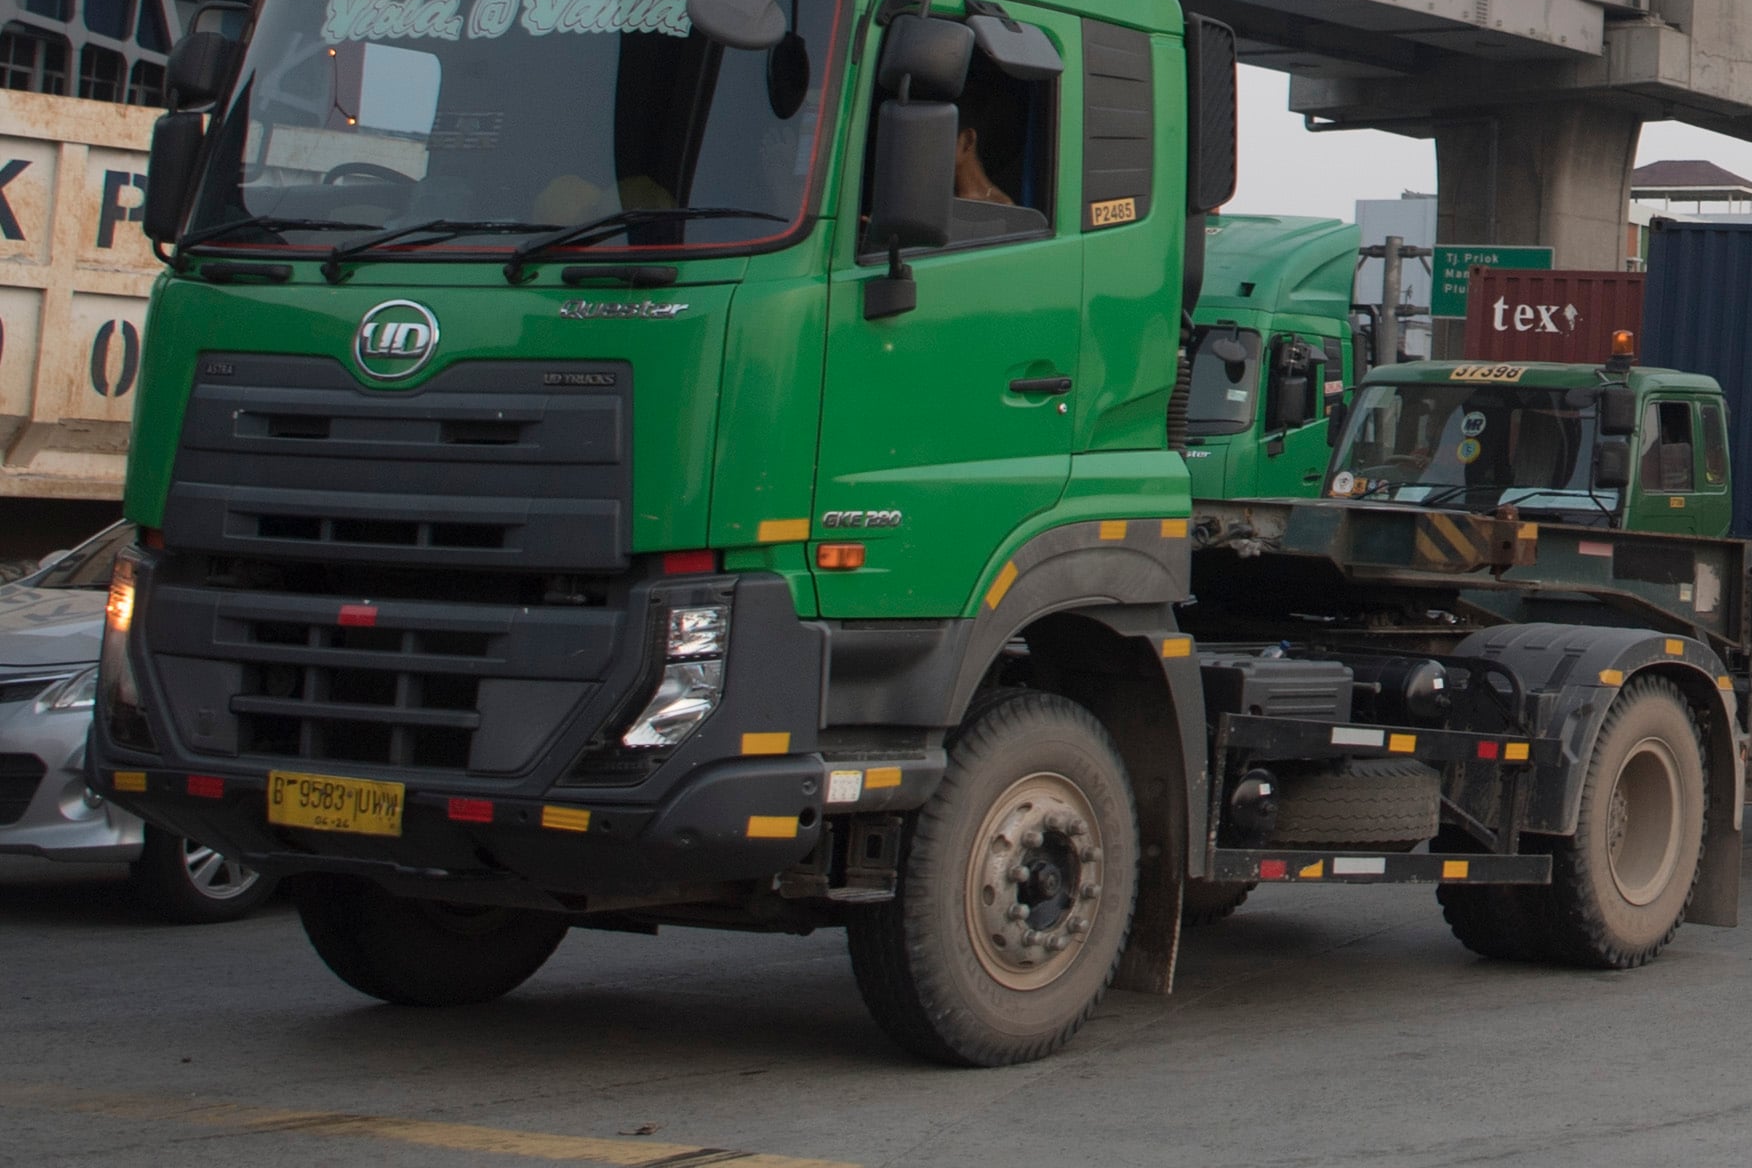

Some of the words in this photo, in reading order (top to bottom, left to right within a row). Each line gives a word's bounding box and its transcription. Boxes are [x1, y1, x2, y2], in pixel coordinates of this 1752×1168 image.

[1094, 202, 1133, 224] P2485
[1464, 253, 1499, 264] Priok
[1444, 269, 1470, 279] Man
[1444, 283, 1468, 294] Plu
[559, 299, 690, 320] Quester
[363, 322, 430, 356] UD
[563, 373, 615, 385] TRUCKS
[1186, 450, 1211, 458] ster
[823, 511, 863, 528] GKE
[865, 510, 902, 528] 280
[273, 776, 285, 805] B
[300, 779, 346, 810] 9583
